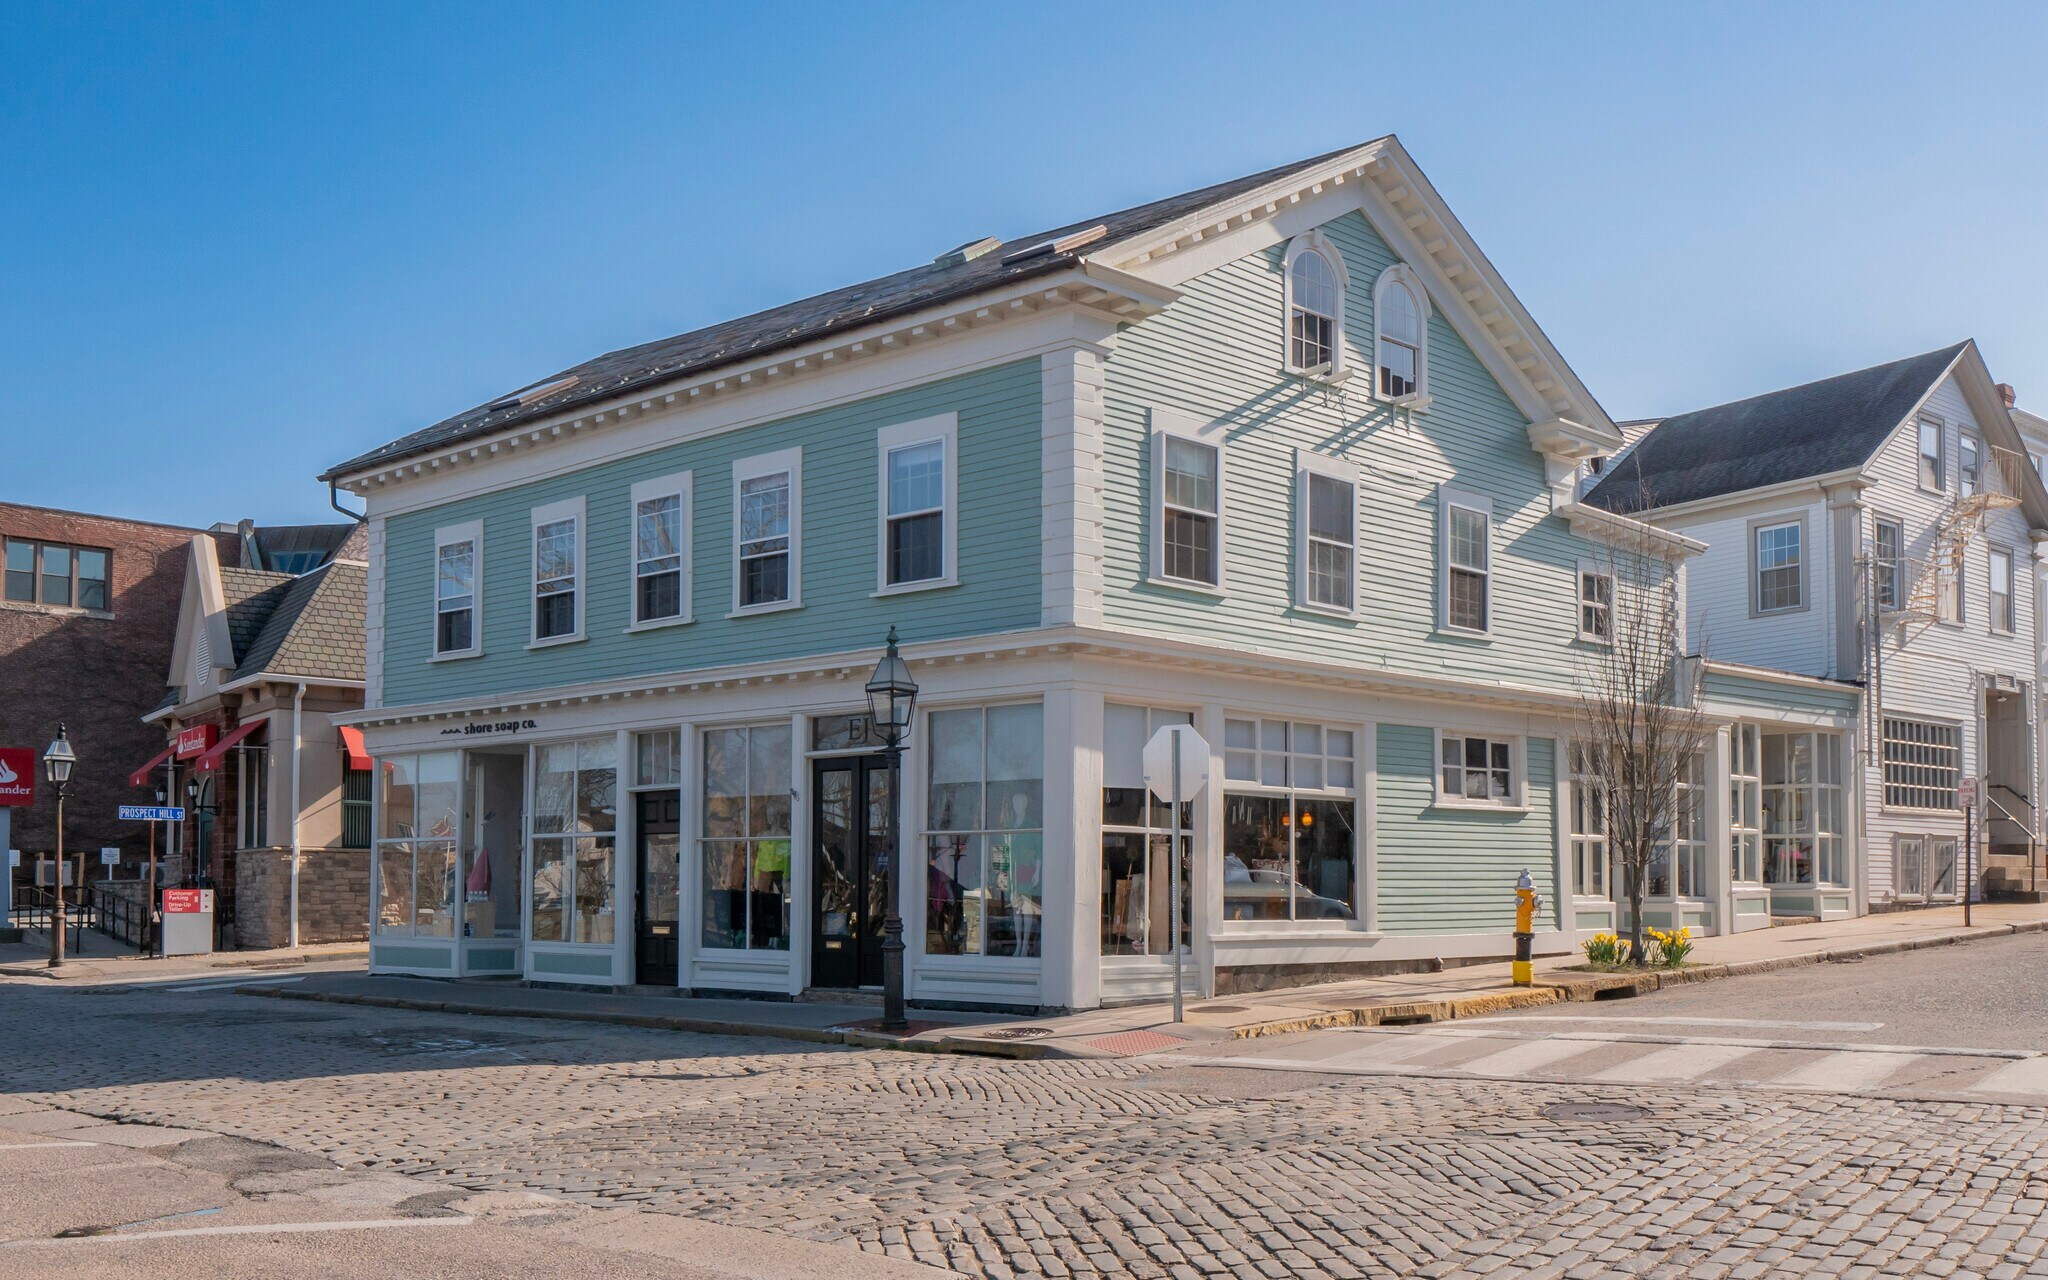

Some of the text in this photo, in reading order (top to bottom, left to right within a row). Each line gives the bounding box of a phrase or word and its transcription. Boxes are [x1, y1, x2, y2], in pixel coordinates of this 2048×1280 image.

[464, 720, 537, 735] shore soap co.
[120, 808, 184, 819] PROSPECT HILL ST
